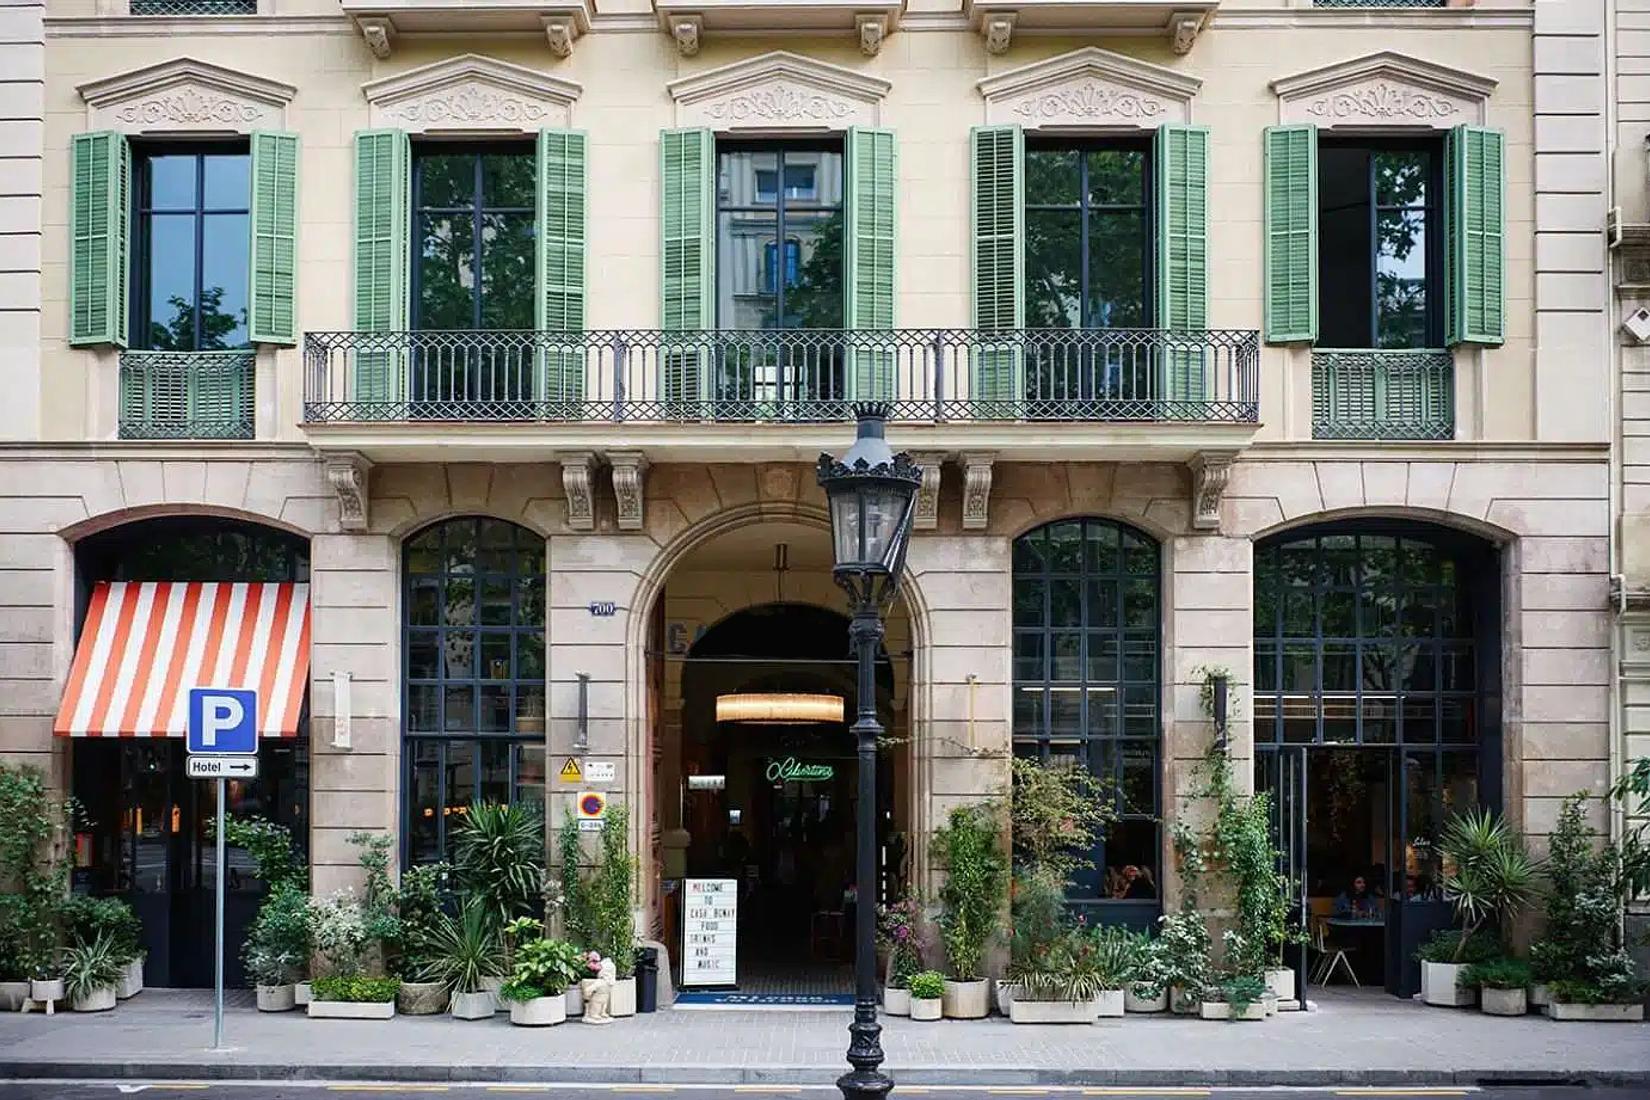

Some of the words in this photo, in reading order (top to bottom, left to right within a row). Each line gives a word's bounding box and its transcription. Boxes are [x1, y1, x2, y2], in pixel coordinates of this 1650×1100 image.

[592, 603, 614, 614] 700
[202, 695, 245, 746] P
[193, 762, 221, 772] Hotel
